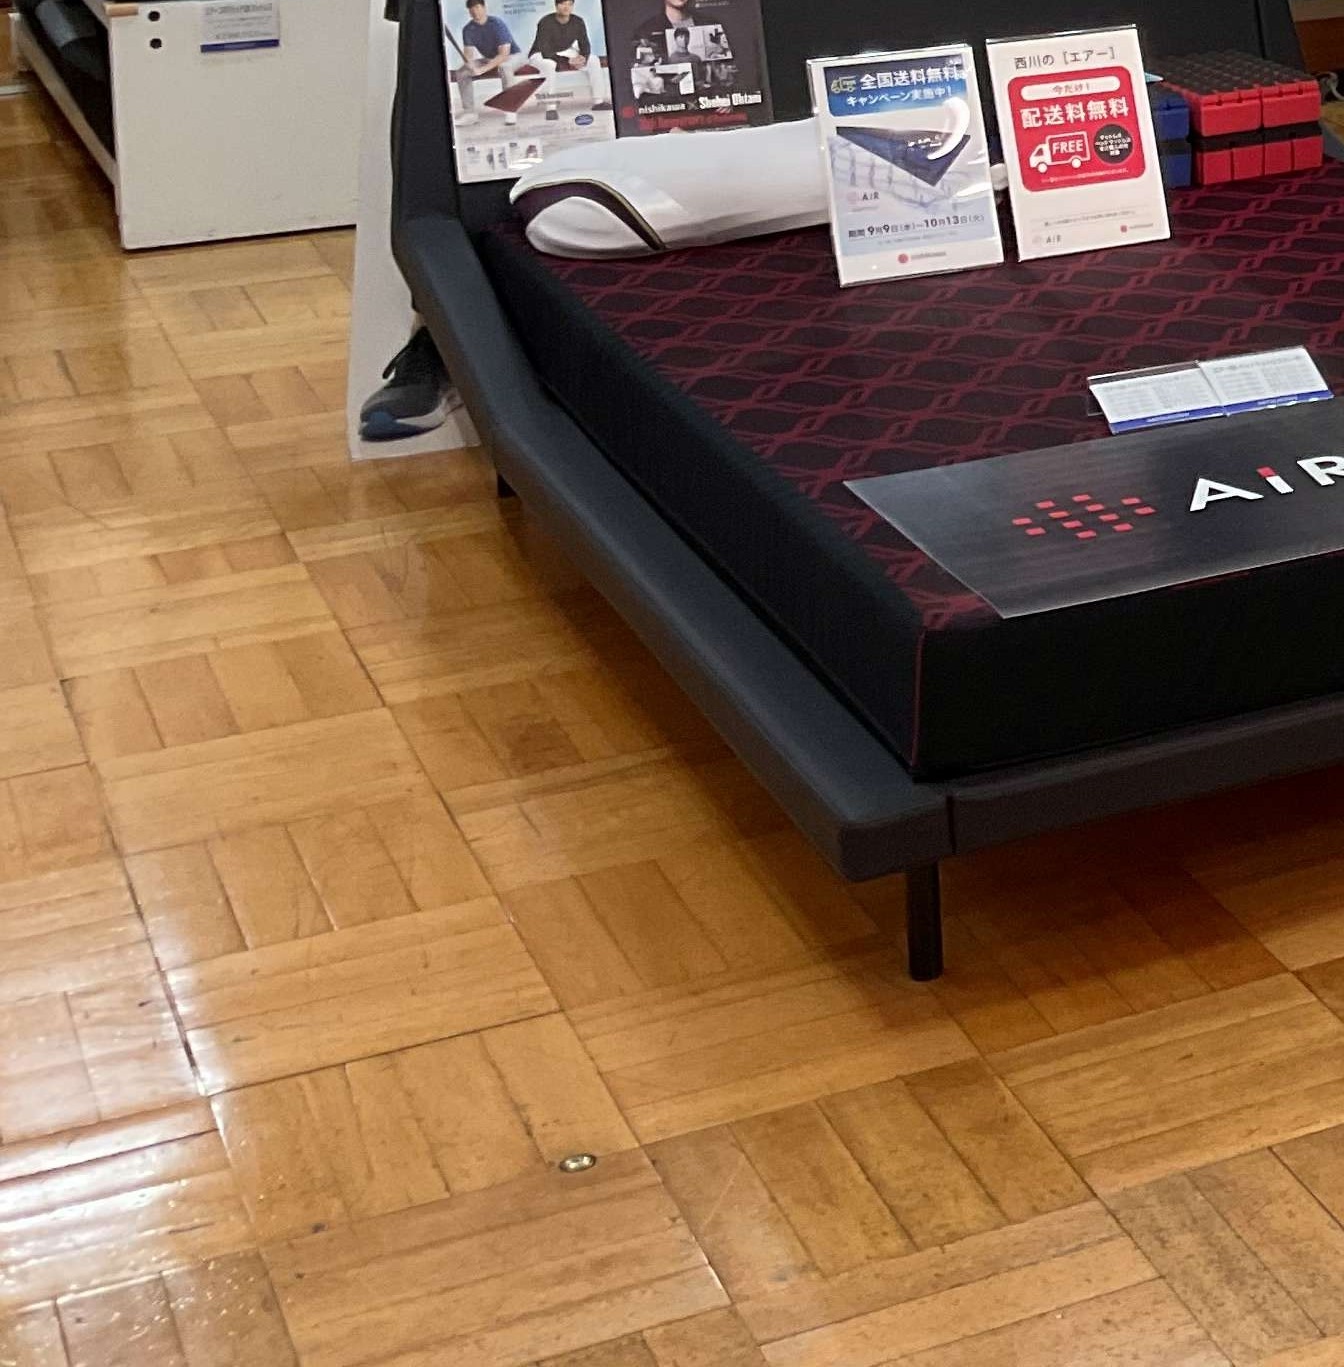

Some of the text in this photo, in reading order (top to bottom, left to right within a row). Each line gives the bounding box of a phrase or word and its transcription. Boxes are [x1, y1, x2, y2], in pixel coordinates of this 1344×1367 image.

[1020, 96, 1129, 129] 配送料無料
[1052, 139, 1084, 156] FREE
